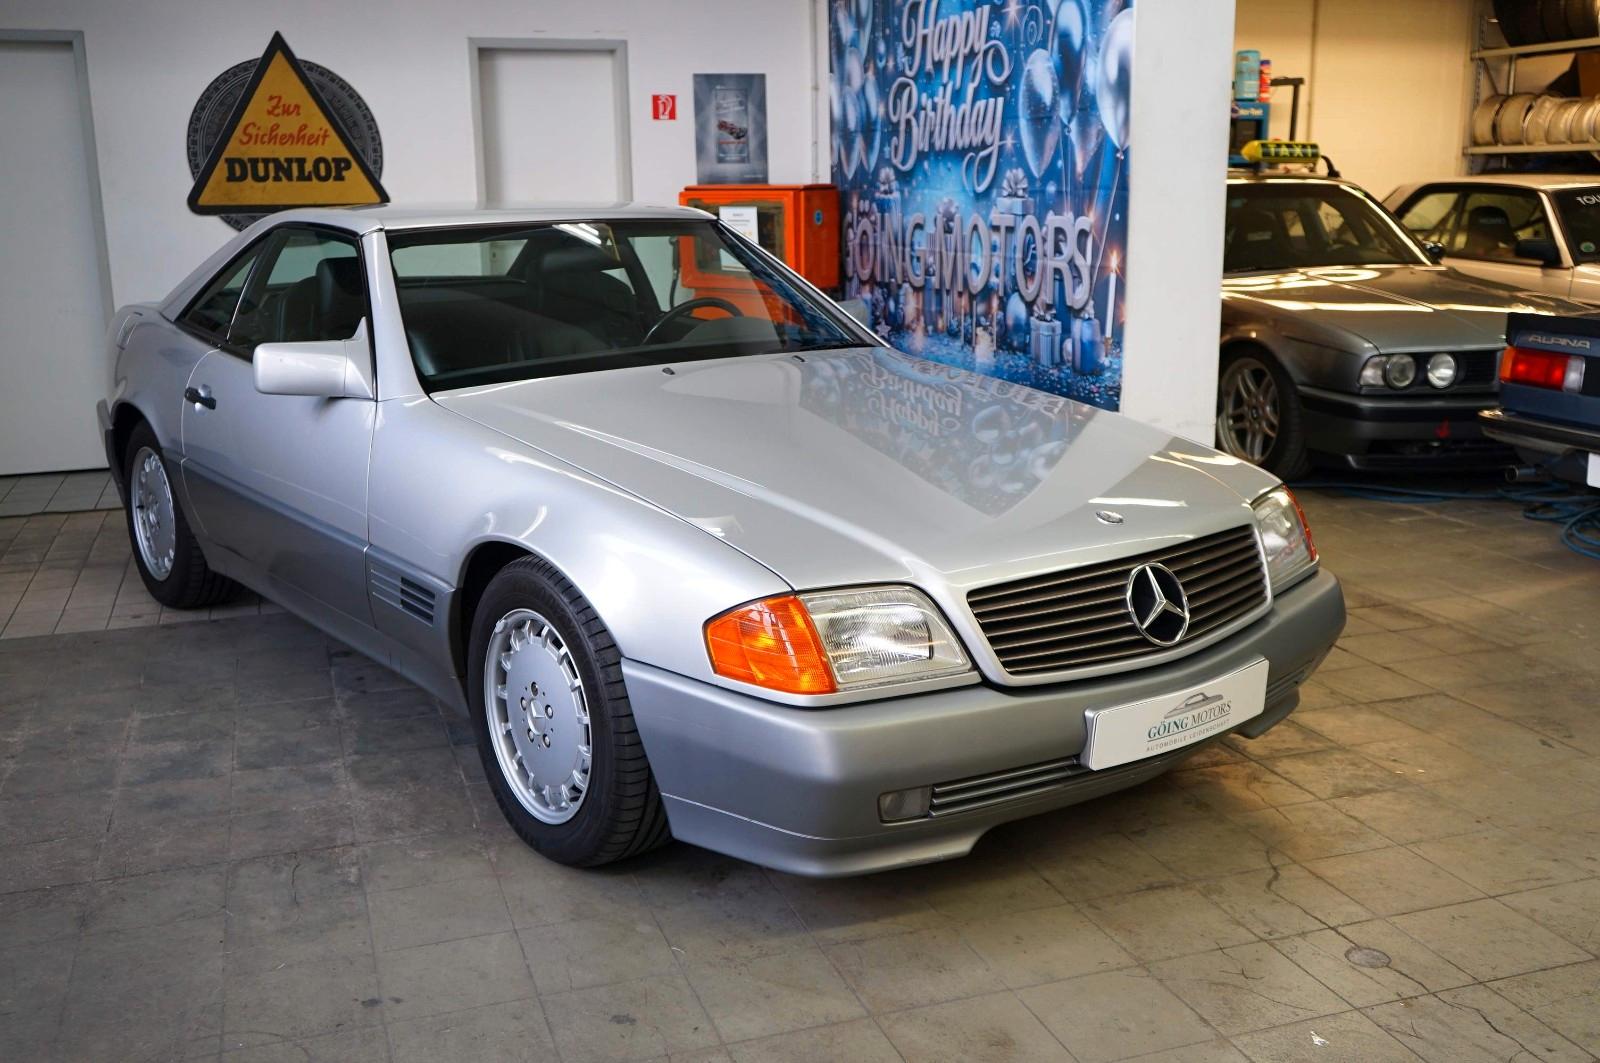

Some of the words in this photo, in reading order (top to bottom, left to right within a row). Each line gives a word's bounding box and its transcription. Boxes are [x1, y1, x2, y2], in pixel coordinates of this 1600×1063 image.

[902, 0, 1009, 88] Happy
[266, 95, 301, 117] Zur
[239, 121, 330, 147] Sicherheit
[889, 77, 1004, 194] Birthday
[1268, 144, 1312, 157] TAXI
[224, 156, 352, 183] DUNLOP
[935, 212, 1093, 310] MOTORS
[1528, 334, 1591, 350] ALPINA
[1147, 717, 1189, 739] GÖING
[1191, 700, 1232, 728] MOTORS
[1146, 735, 1188, 752] AUTOMOBILE
